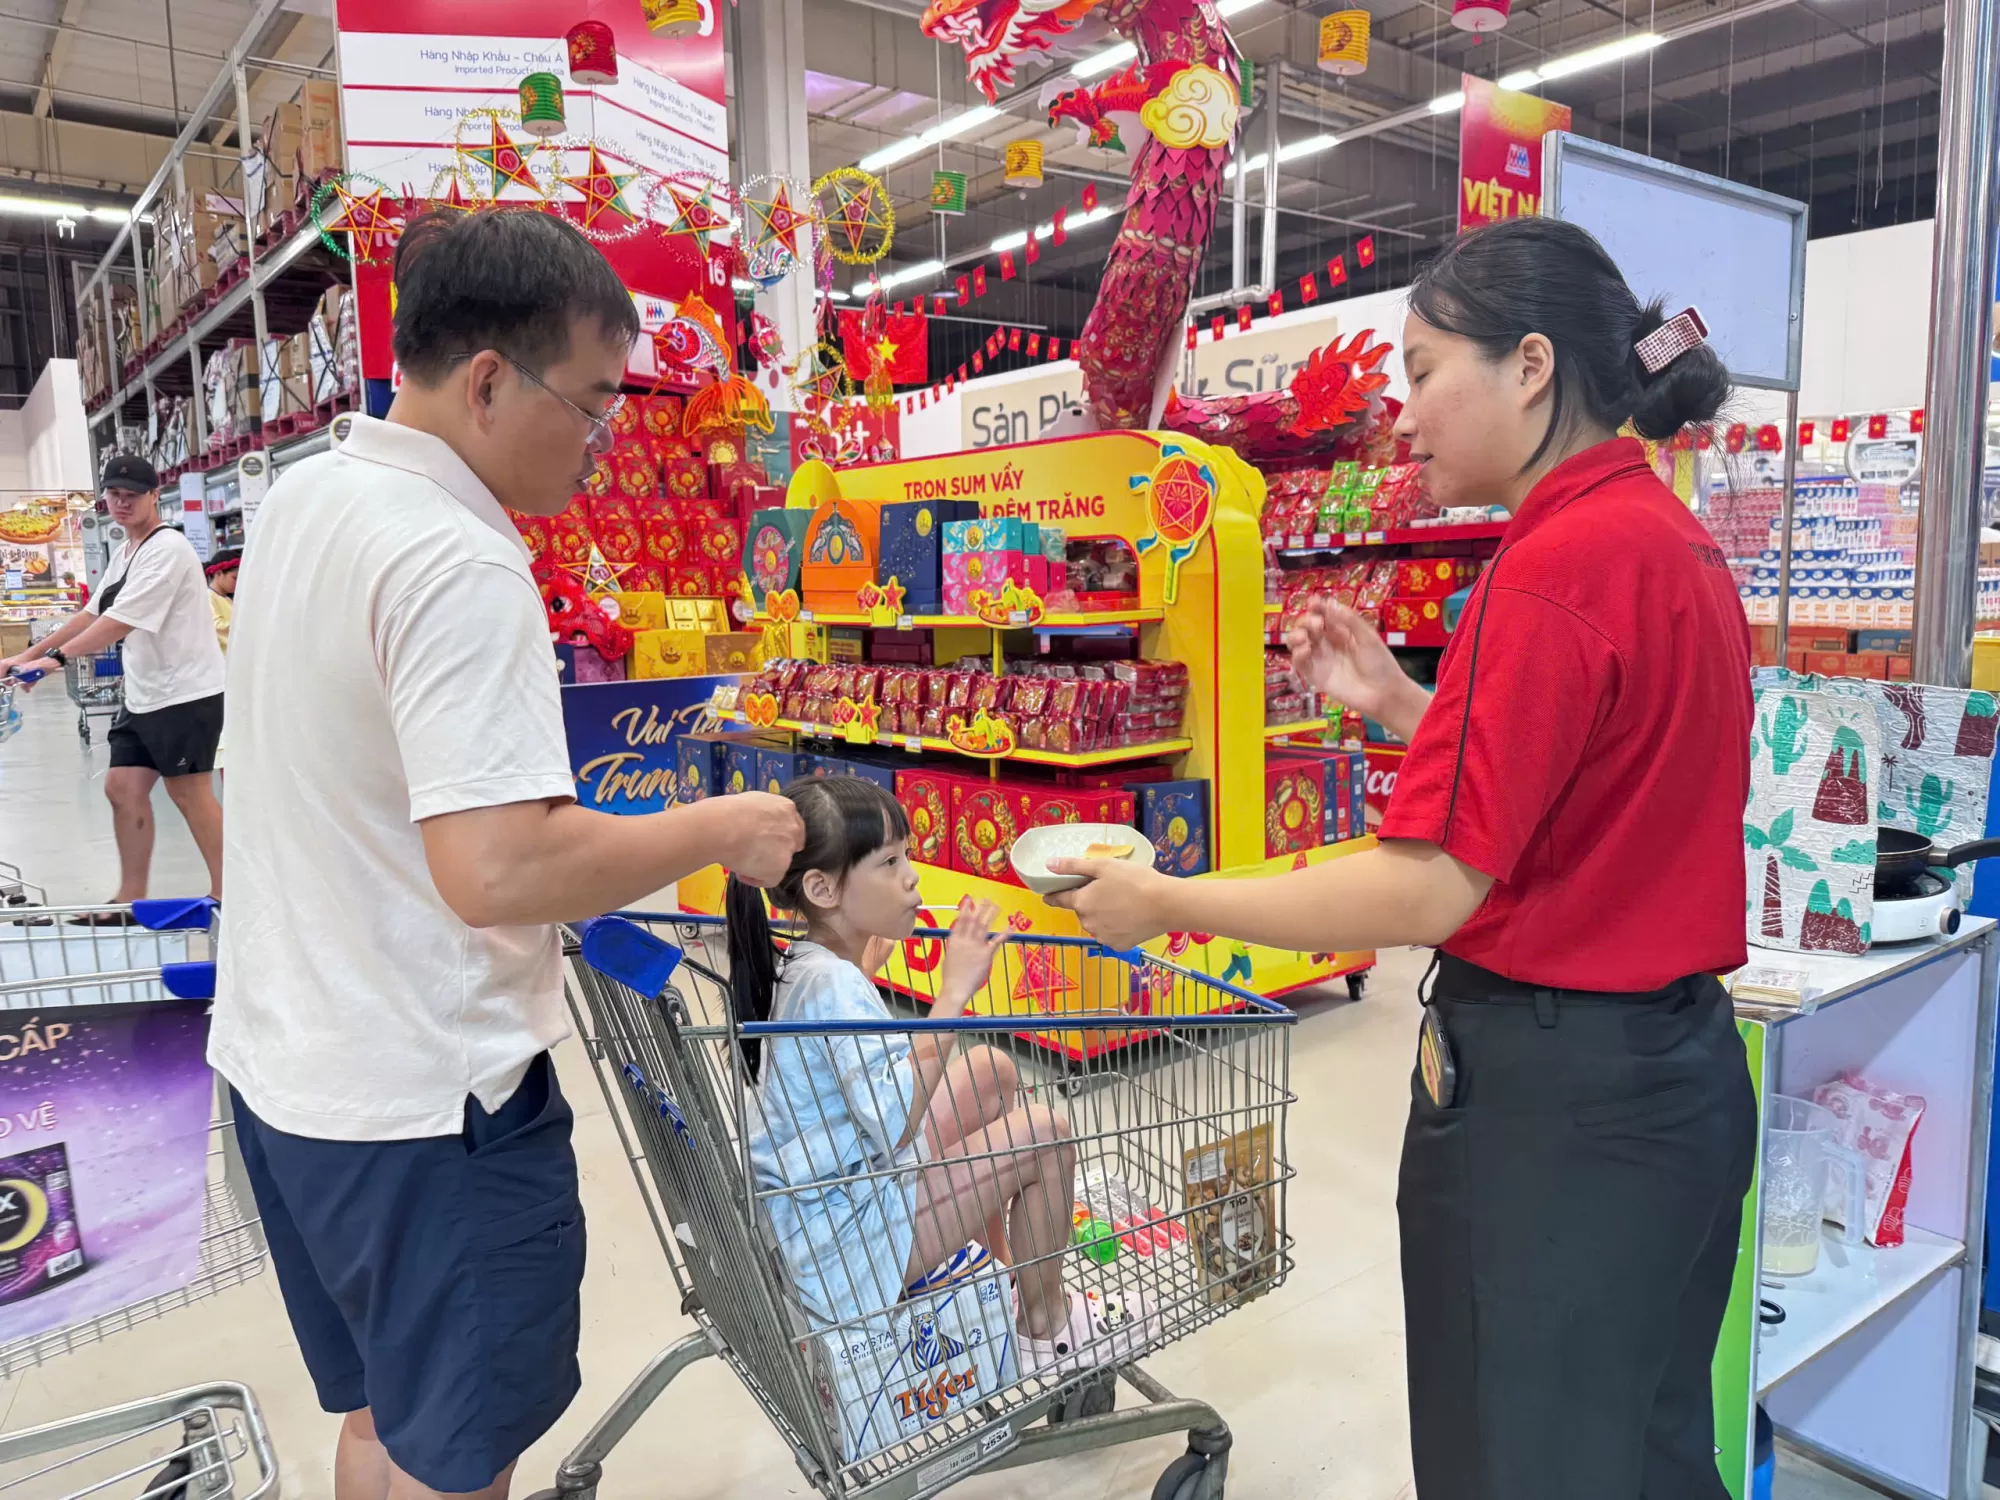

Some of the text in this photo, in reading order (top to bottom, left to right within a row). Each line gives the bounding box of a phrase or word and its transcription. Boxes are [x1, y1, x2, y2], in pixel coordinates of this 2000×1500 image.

[420, 49, 448, 64] Hàng
[451, 50, 479, 64] Nhập
[482, 50, 510, 63] Khẩu
[523, 51, 550, 63] Châu
[455, 66, 494, 74] Imported
[425, 105, 452, 118] Hàng
[1463, 176, 1513, 222] VIỆT
[708, 257, 726, 286] 16
[972, 403, 1028, 447] Sản
[951, 474, 986, 496] SUM
[1036, 491, 1105, 521] TRĂNG
[611, 705, 679, 747] Vui
[893, 1363, 979, 1421] Tiger
